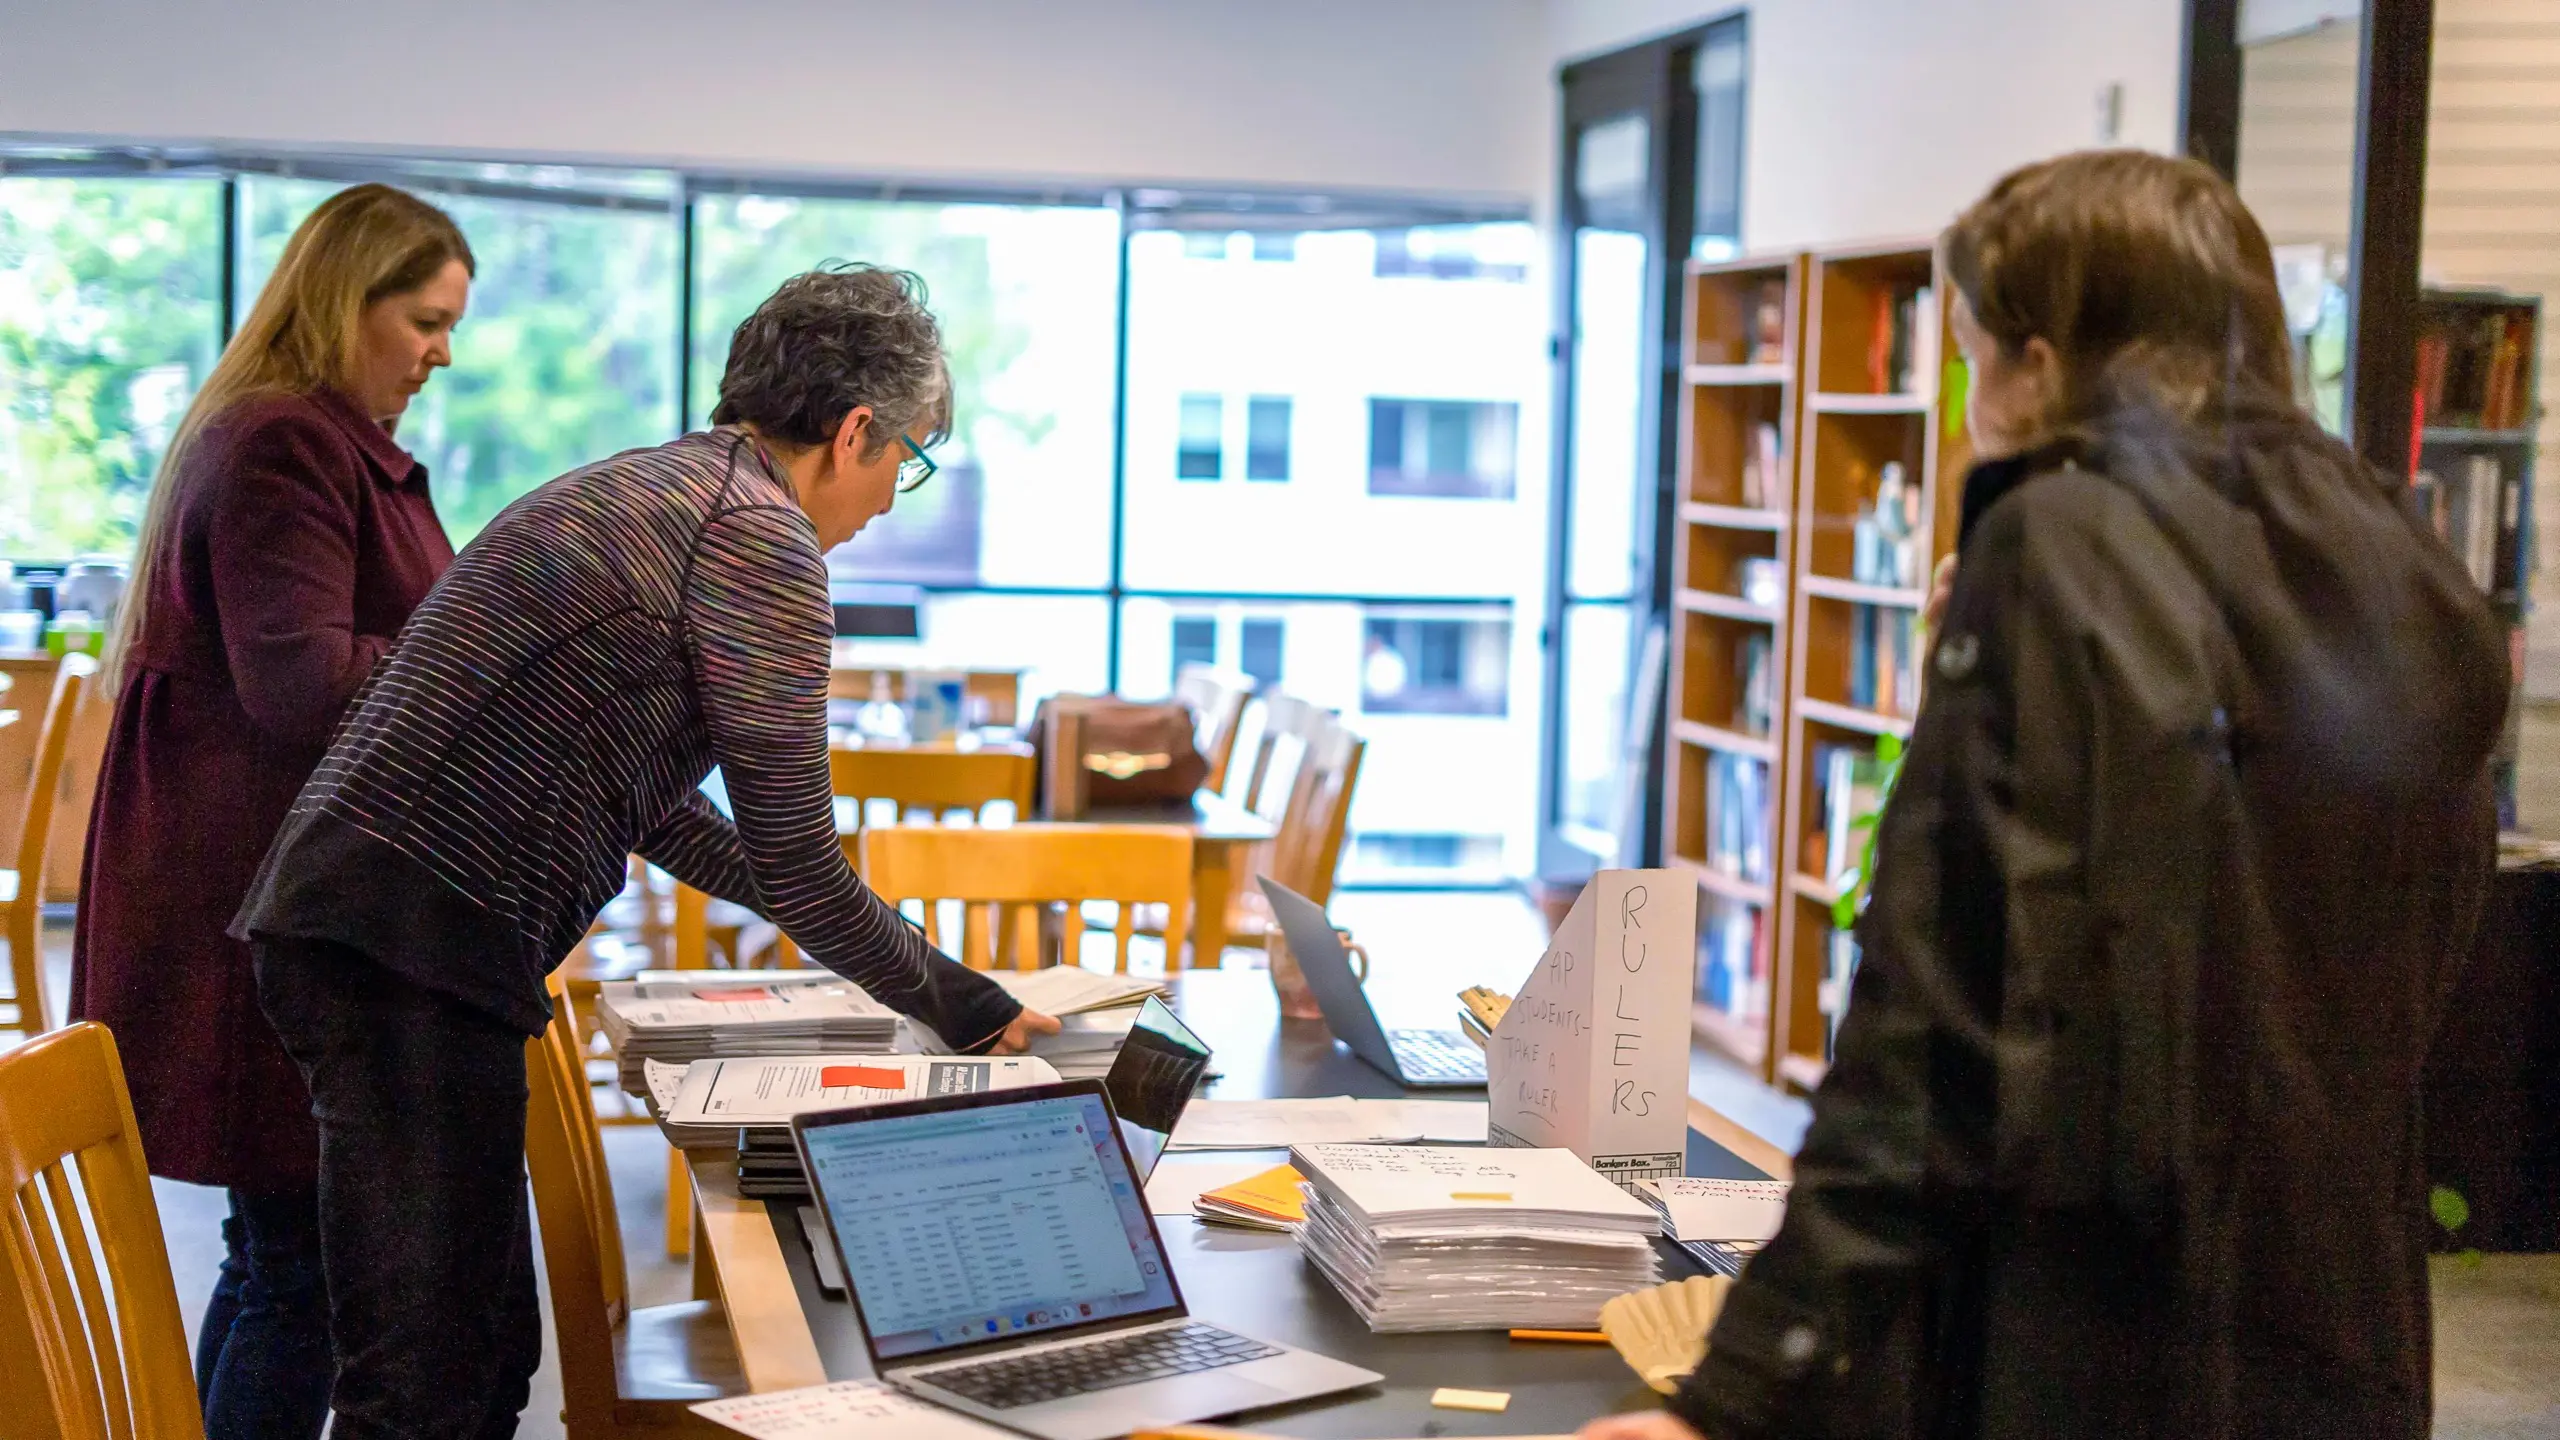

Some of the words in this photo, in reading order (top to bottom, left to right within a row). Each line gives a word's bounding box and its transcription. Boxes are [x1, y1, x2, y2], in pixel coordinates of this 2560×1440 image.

[1549, 950, 1575, 988] AP
[1612, 884, 1657, 1117] RULERS
[1500, 1036, 1539, 1071] TAKE
[1548, 1052, 1556, 1075] A
[1517, 1080, 1559, 1114] RULER
[1595, 1158, 1629, 1169] Bankers
[1665, 1160, 1677, 1168] 723
